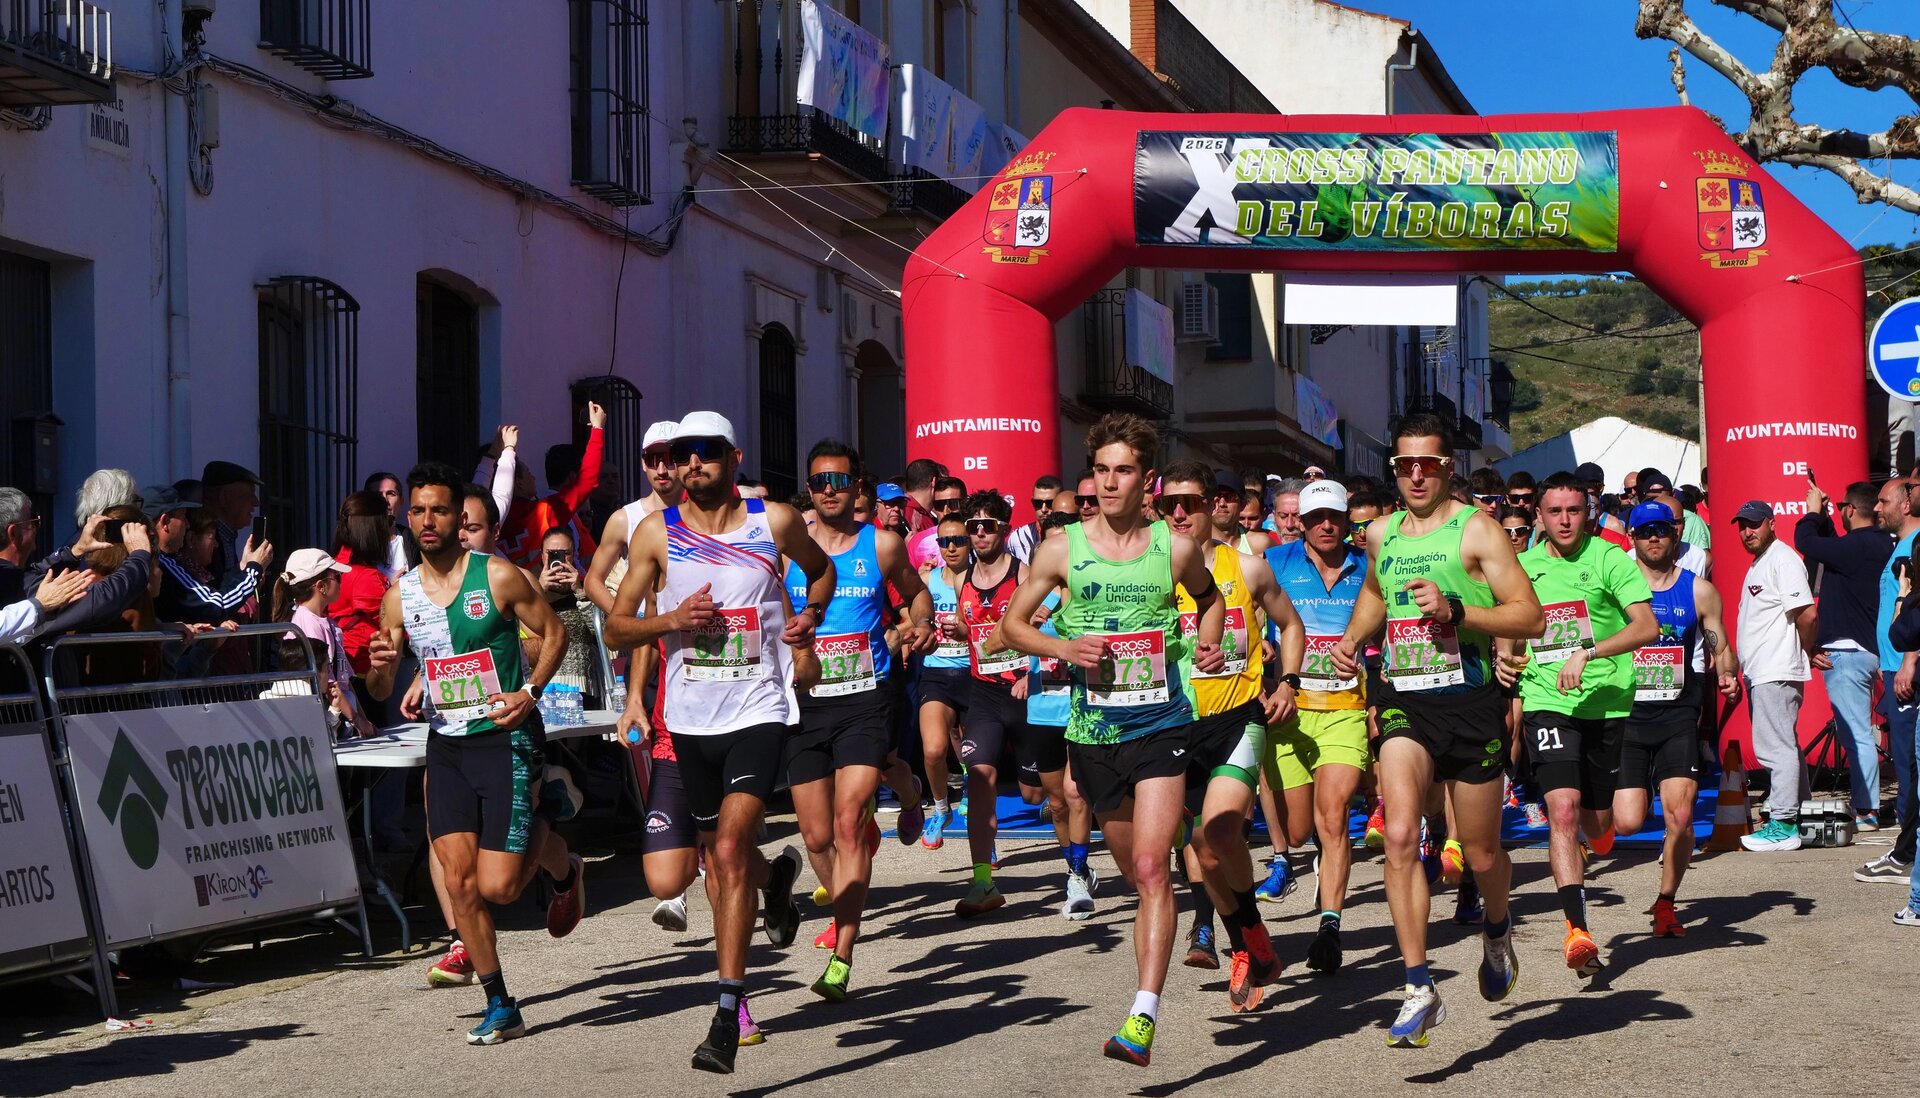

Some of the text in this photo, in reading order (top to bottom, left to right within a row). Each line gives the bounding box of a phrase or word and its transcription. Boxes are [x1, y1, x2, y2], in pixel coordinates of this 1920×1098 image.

[1185, 140, 1224, 150] 2026
[1234, 147, 1579, 186] CROSS PANTANO
[1164, 138, 1271, 243] X
[1234, 192, 1571, 240] DEL VÍBORAS
[1719, 259, 1748, 267] MARTOS
[916, 418, 1041, 438] AYUNTAMIENTO
[1726, 422, 1857, 442] AYUNTAMIENTO
[964, 457, 988, 470] DE
[1783, 462, 1808, 475] DE
[1768, 502, 1835, 515] ARTS
[1395, 552, 1447, 565] Fundación
[1394, 563, 1430, 575] Unicaja
[1105, 583, 1161, 593] Fundación
[1105, 593, 1146, 605] Unicaja
[706, 616, 747, 627] CROSS
[1184, 615, 1196, 628] X
[691, 627, 738, 636] PANTANO
[978, 627, 985, 637] X
[1393, 623, 1442, 637] X CROSS
[815, 639, 860, 652] X CROSS
[1110, 639, 1152, 651] CROSS
[1306, 637, 1317, 648] X
[1393, 634, 1433, 644] PANTANO
[1395, 643, 1446, 668] 872
[1633, 650, 1643, 660] X
[433, 659, 481, 674] X CROSS
[821, 653, 861, 677] 437
[1100, 656, 1153, 684] 873
[435, 670, 474, 681] PANTANO
[440, 674, 483, 703] 871
[1537, 727, 1564, 751] 21
[166, 736, 324, 830] TECNOCASA
[185, 825, 335, 864] FRANCHISING NETWORK
